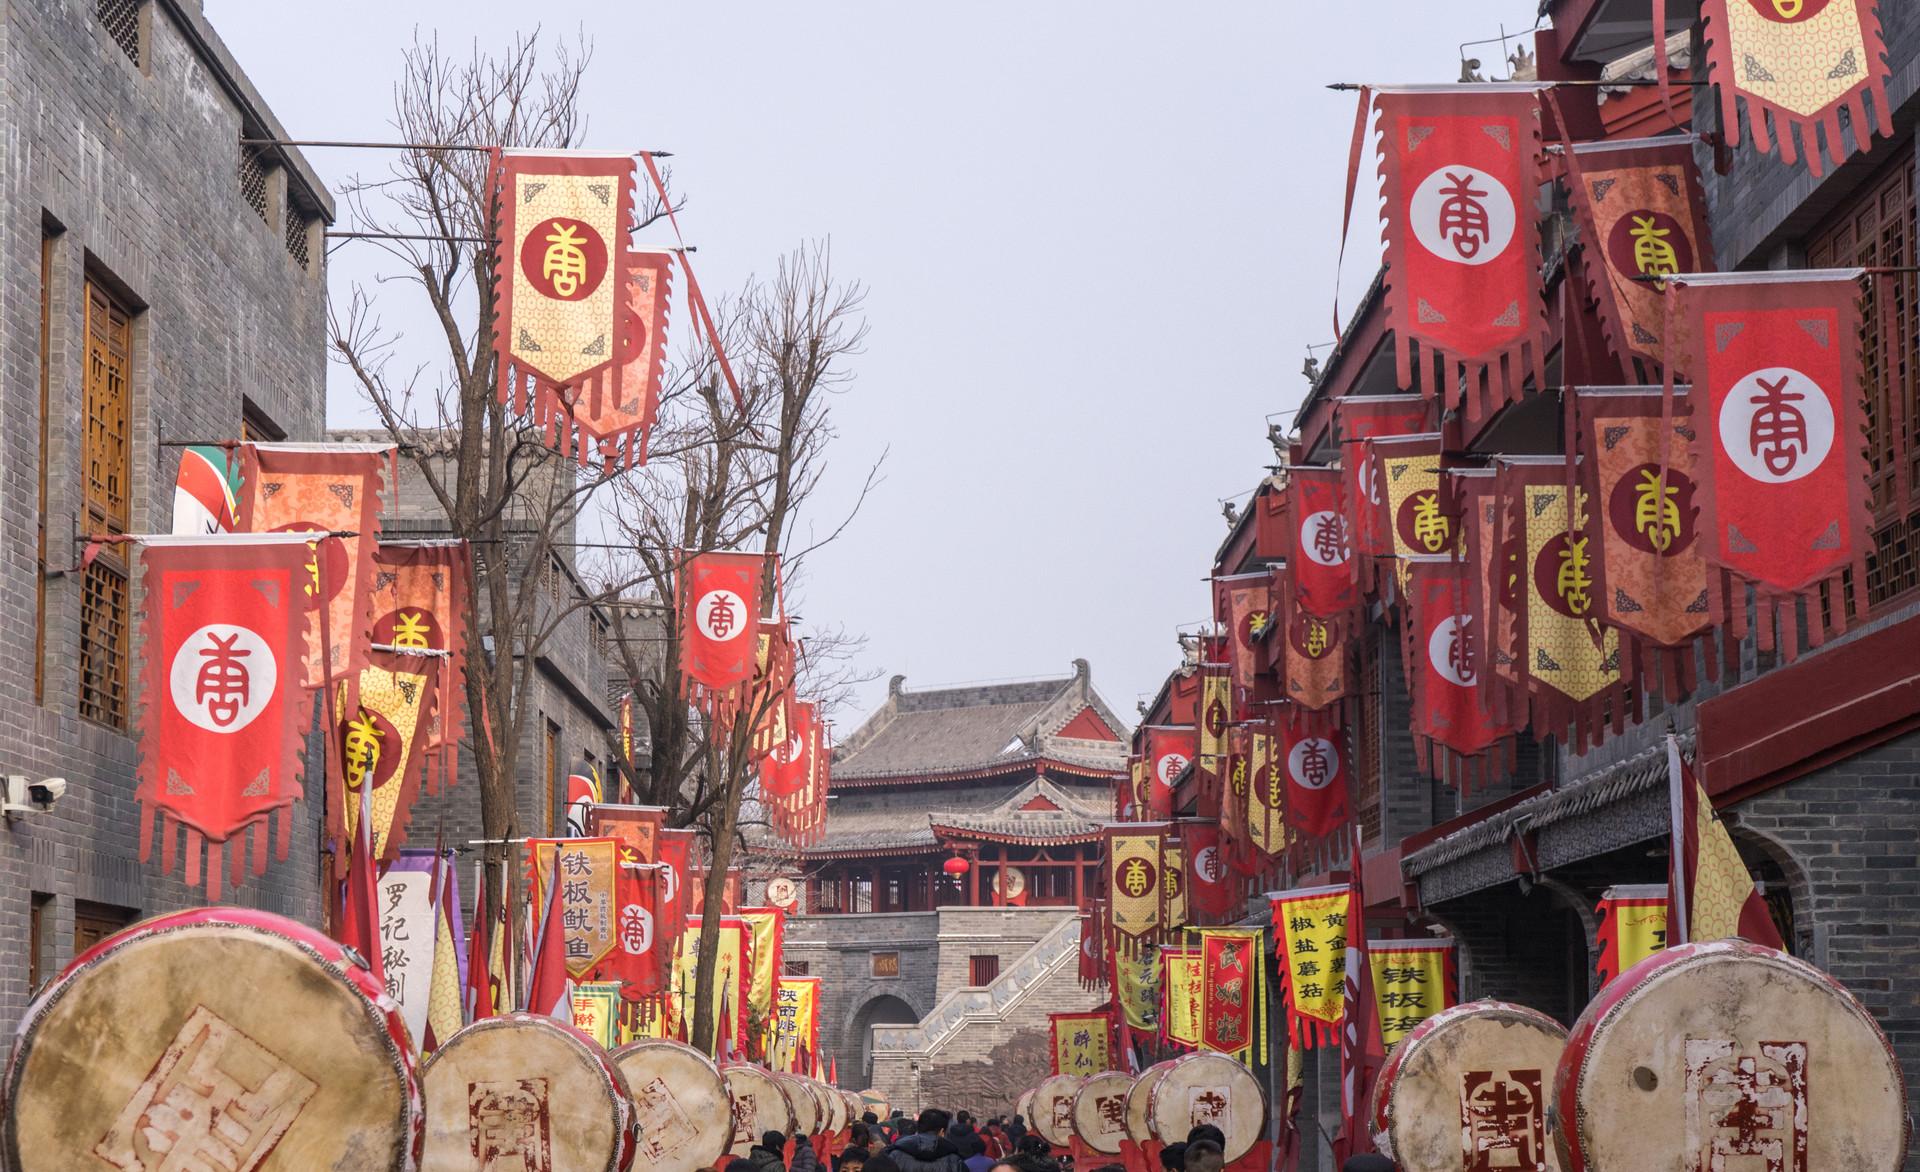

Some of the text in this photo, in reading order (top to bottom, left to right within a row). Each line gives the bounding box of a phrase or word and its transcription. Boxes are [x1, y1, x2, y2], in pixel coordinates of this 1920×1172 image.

[380, 882, 411, 1007] 罗记秘制
[561, 851, 594, 960] 铁板鱿鱼
[1290, 916, 1323, 1000] 椒盐蘑菇
[1073, 1029, 1093, 1078] 醉仙
